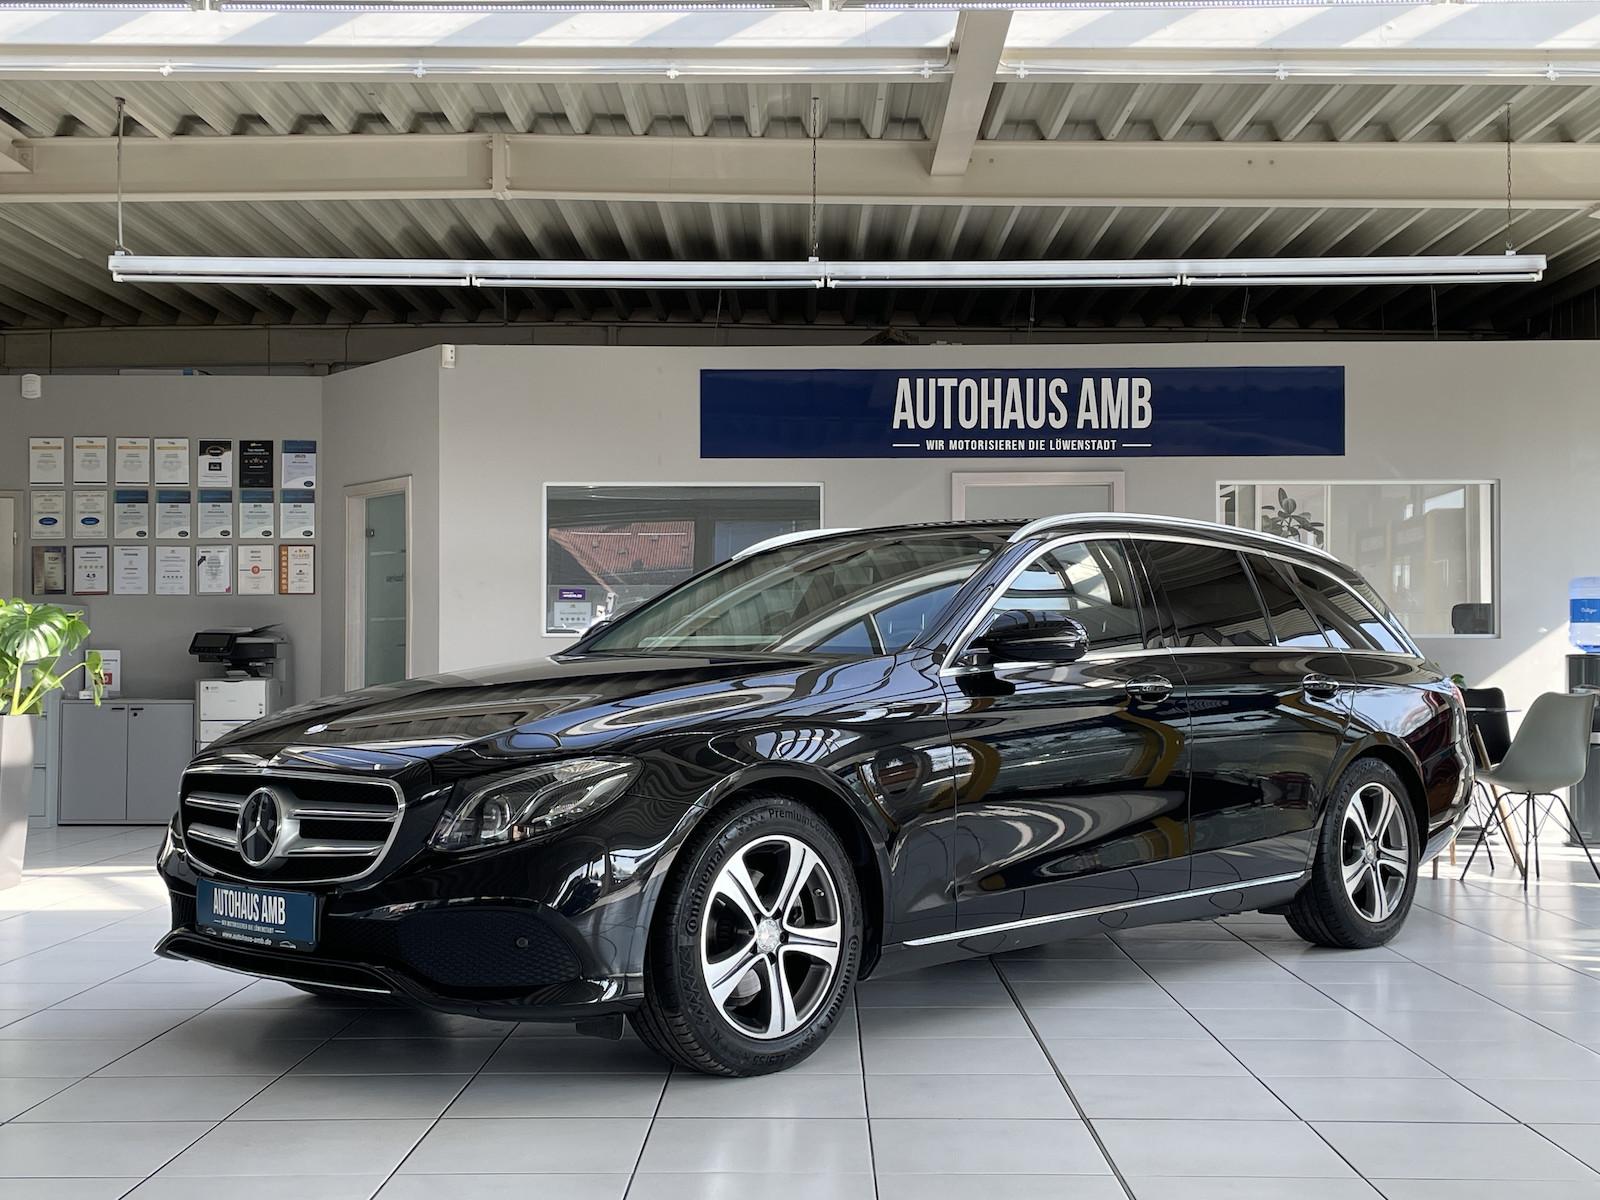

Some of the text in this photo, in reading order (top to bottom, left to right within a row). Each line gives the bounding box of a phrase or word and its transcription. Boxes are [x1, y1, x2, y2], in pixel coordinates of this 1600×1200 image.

[892, 377, 1153, 430] AUTOHAUS AMB
[925, 437, 1117, 451] WIR MOTORISIEREN DIE LÖWENSTADT
[213, 887, 286, 925] AUTOHAUS AMB
[686, 841, 728, 937] Continental
[827, 934, 860, 1026] Continental
